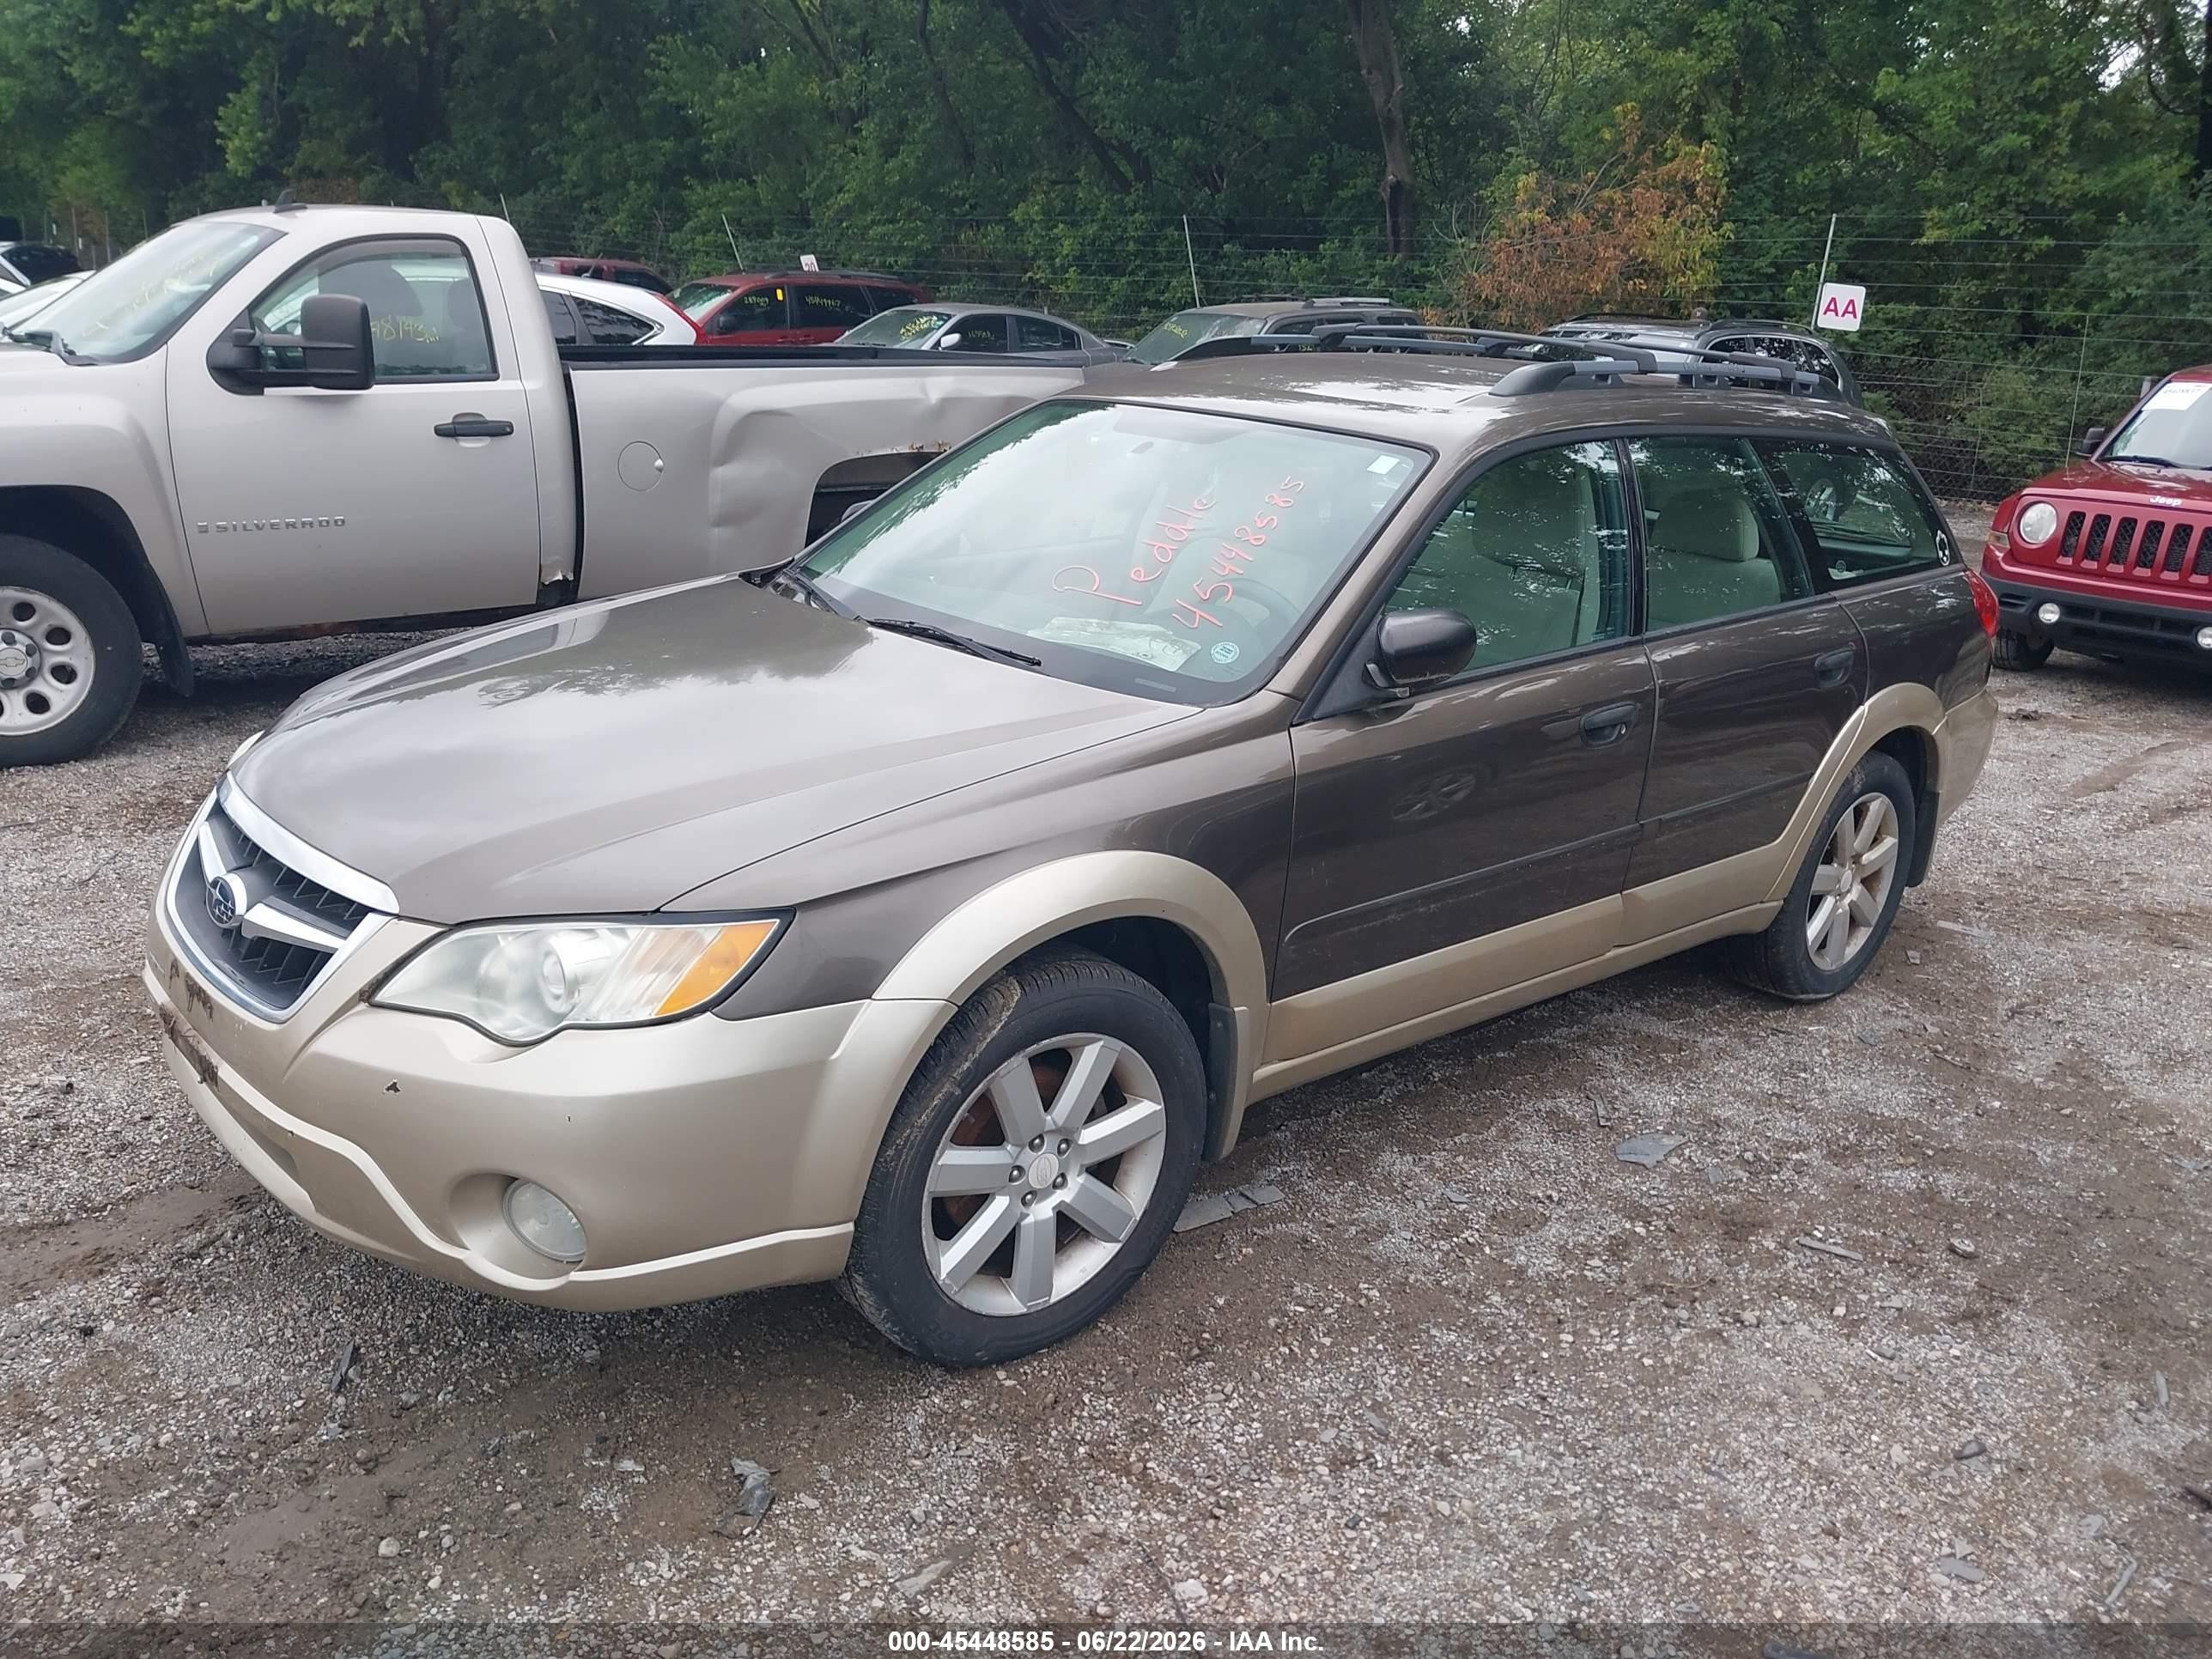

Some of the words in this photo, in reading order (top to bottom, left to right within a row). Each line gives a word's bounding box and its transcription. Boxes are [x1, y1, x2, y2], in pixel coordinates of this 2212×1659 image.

[1822, 296, 1857, 319] AA
[2149, 495, 2182, 507] Jeep
[216, 517, 345, 533] SILVERADO
[1054, 496, 1218, 605] Peddle
[1173, 475, 1304, 629] 45448585
